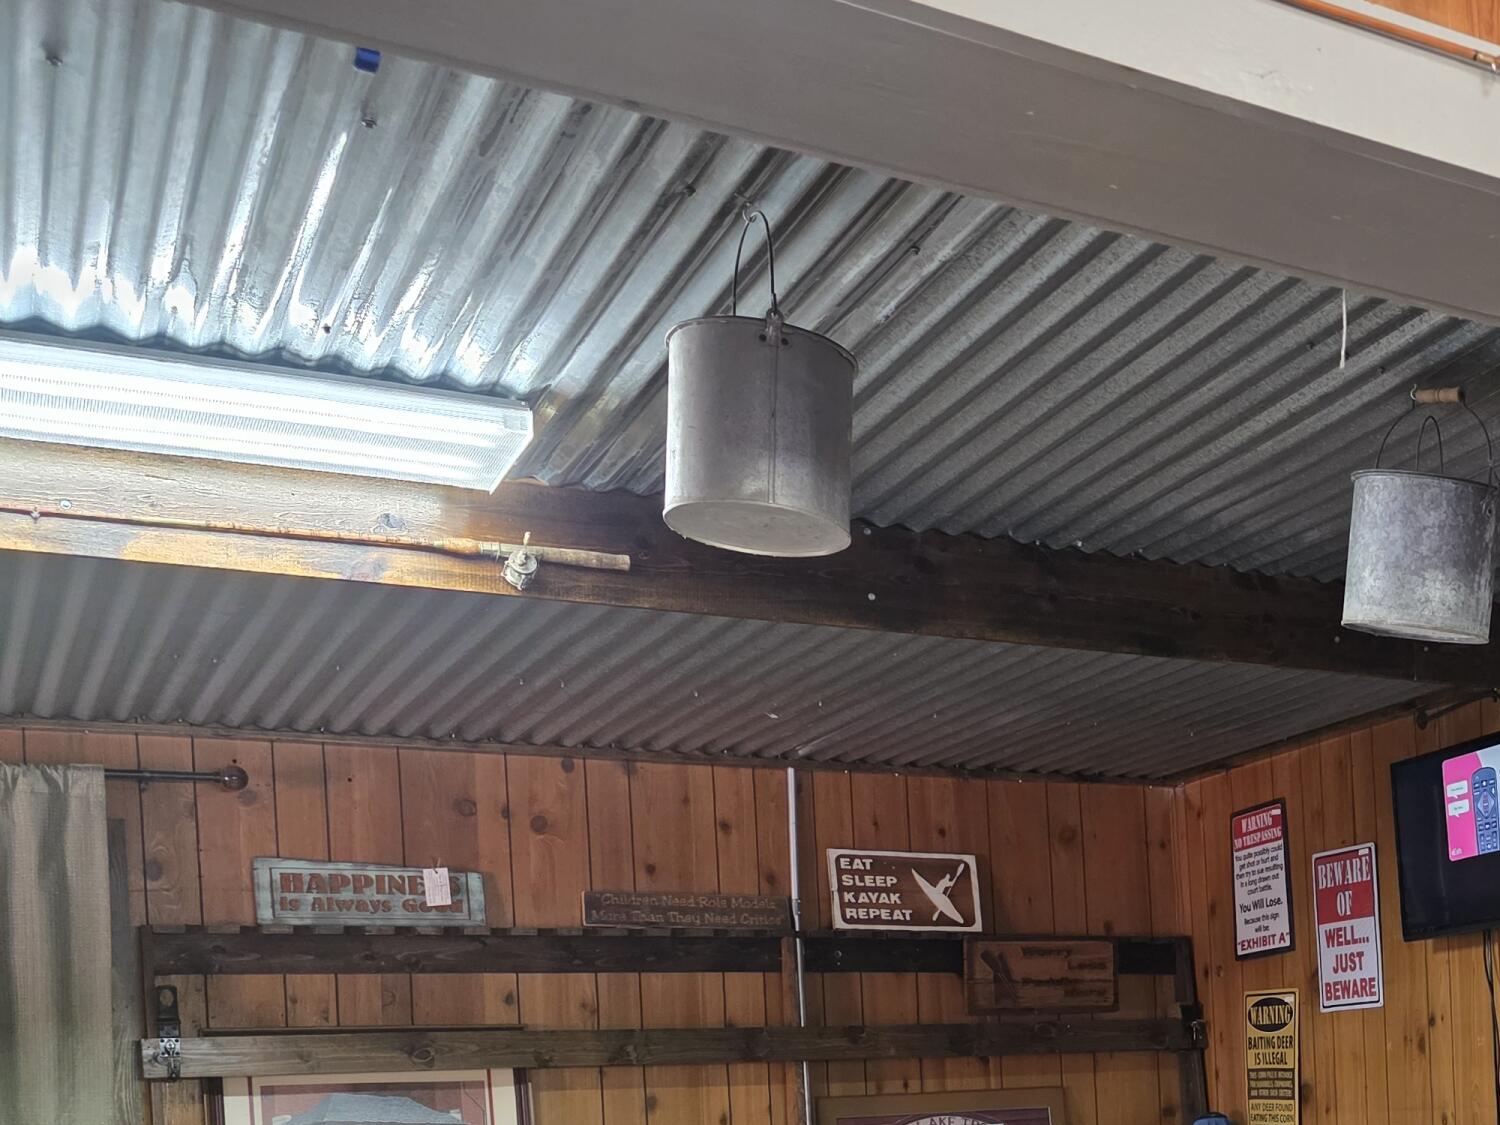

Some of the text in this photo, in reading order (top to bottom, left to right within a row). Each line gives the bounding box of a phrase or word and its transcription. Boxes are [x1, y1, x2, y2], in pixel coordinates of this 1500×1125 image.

[1242, 812, 1273, 833] WARNING
[1234, 826, 1283, 849] NO TRESPASSING
[840, 857, 873, 871] EAT
[1246, 859, 1256, 868] shot
[1261, 857, 1270, 865] hurt
[1317, 855, 1371, 890] BEWARE
[279, 872, 461, 896] HAPPINES
[841, 874, 898, 888] SLEEP
[1248, 877, 1257, 888] long
[310, 896, 393, 915] Always
[663, 895, 697, 907] Need
[699, 896, 727, 908] Role
[731, 898, 777, 909] Models
[843, 891, 902, 905] KAYAK
[1239, 896, 1283, 913] You Will Lose.
[1336, 890, 1353, 917] OF
[632, 910, 665, 924] Than
[668, 911, 700, 926] They
[704, 912, 738, 925] Need
[845, 907, 913, 921] REPEAT
[1261, 913, 1270, 923] this
[1270, 911, 1279, 922] sign
[1255, 924, 1263, 933] will
[1325, 925, 1370, 949] WELL...
[1332, 951, 1364, 975] JUST
[1325, 977, 1377, 1002] BEWARE
[1250, 1005, 1291, 1025] WARNING
[1248, 1035, 1293, 1050] BAITING DEER
[1254, 1051, 1288, 1065] IS ILLEGAL
[1251, 1103, 1293, 1112] ANY DEER FOUND
[1250, 1113, 1294, 1123] EATING THIS CORN
